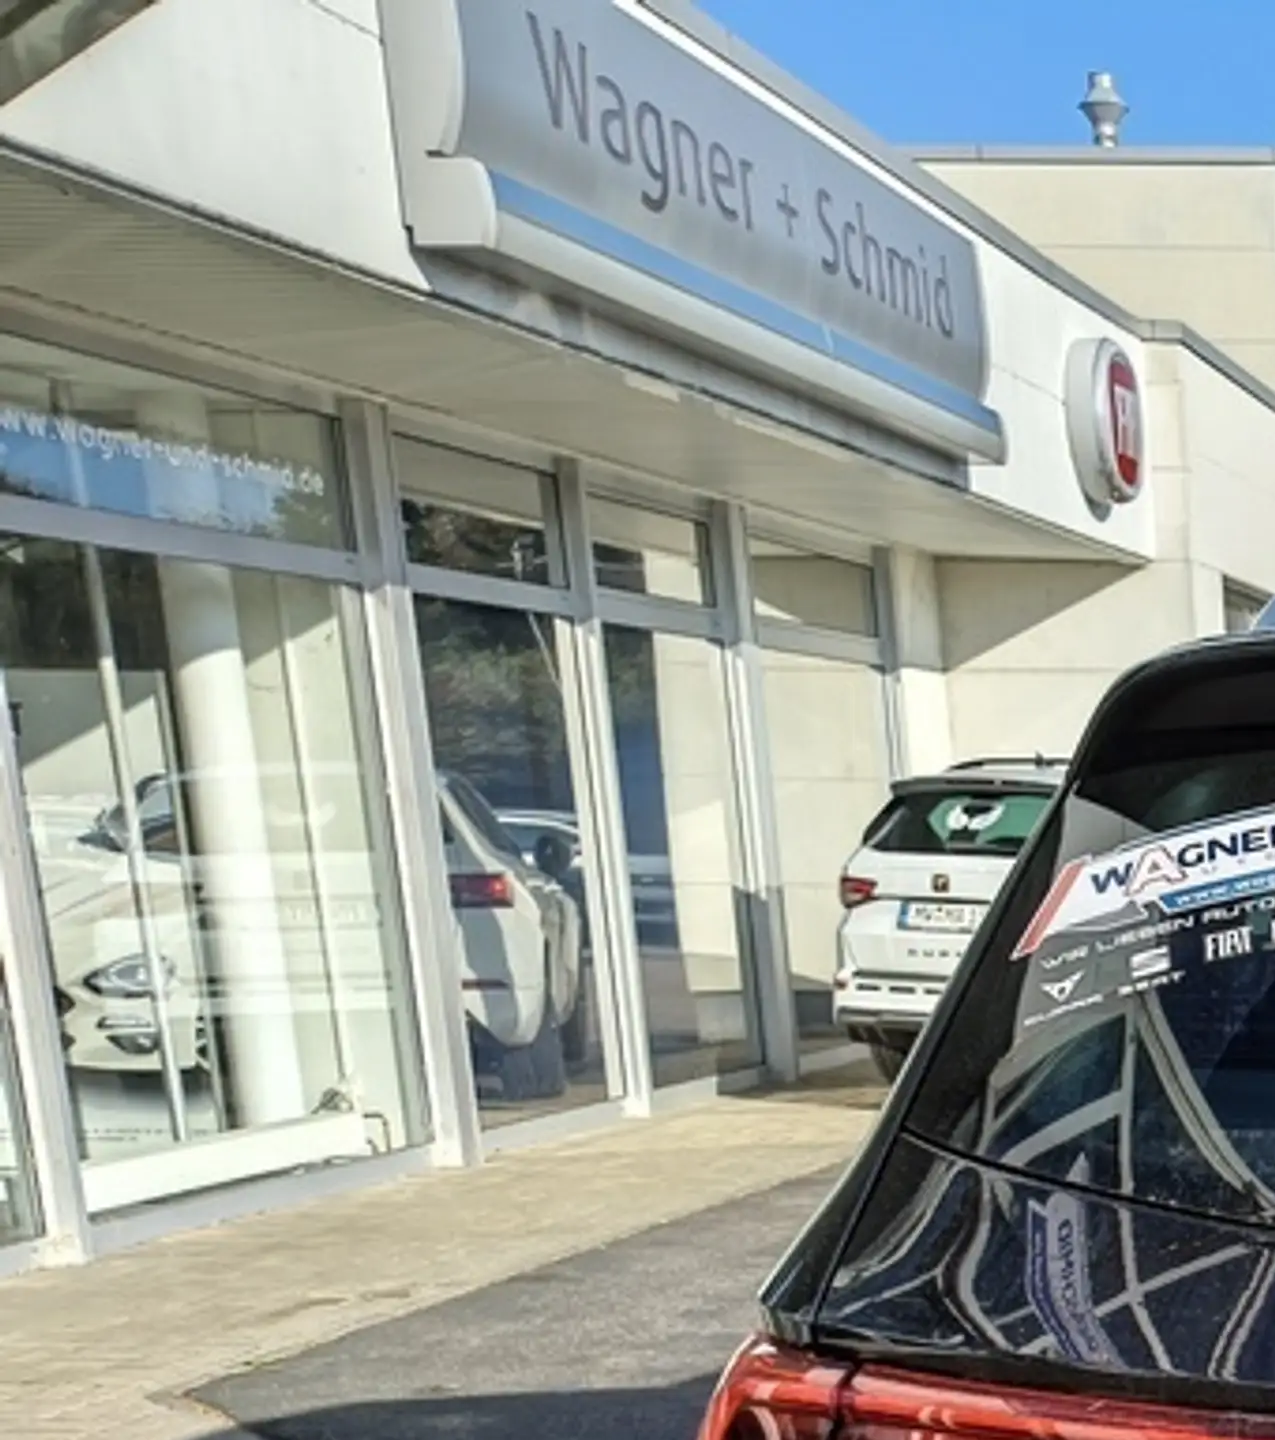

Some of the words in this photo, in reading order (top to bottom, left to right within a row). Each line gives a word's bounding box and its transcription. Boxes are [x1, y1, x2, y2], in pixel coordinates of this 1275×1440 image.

[525, 10, 754, 231] Wagner
[775, 183, 799, 238] +
[815, 187, 954, 339] Schmid
[1204, 925, 1252, 962] FIAT
